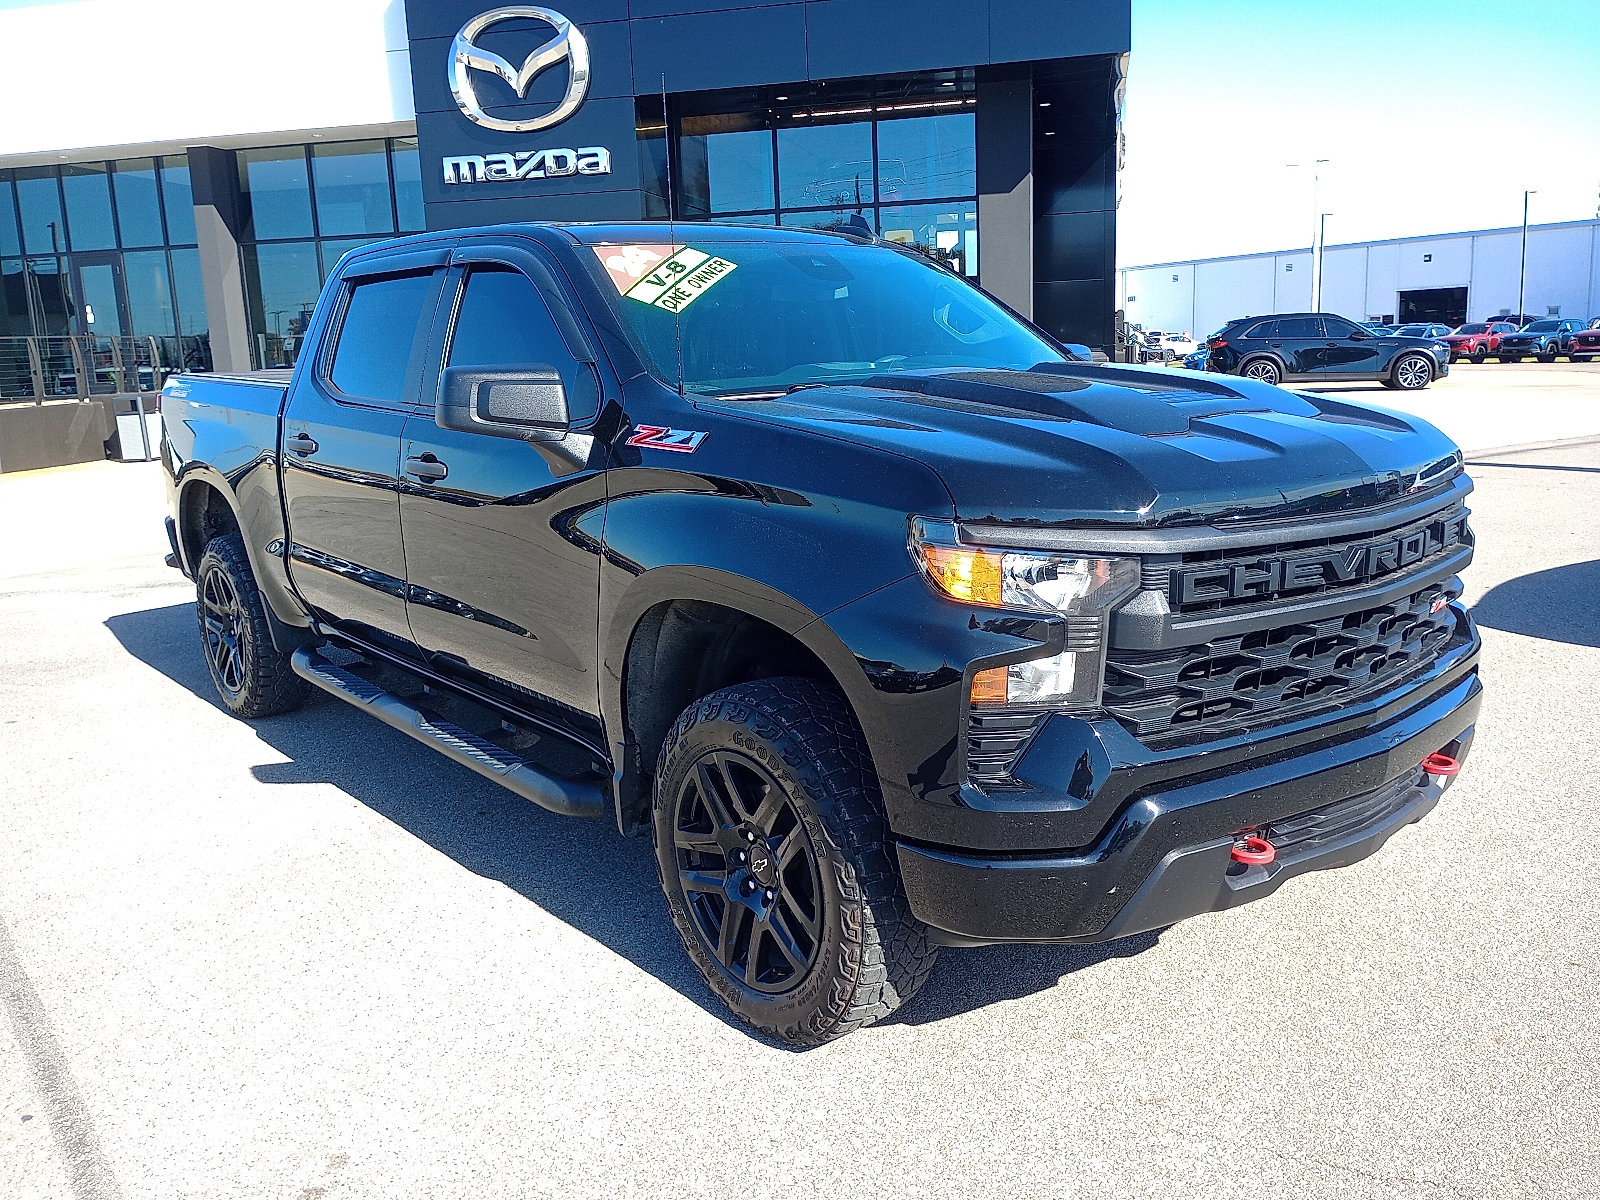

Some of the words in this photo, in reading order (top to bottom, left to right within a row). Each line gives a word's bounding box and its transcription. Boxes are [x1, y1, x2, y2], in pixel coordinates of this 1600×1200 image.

[442, 146, 612, 184] mazda
[645, 261, 687, 287] V-8
[661, 286, 693, 310] ONE
[688, 259, 731, 289] OWNER
[625, 423, 710, 454] Z71
[1170, 506, 1471, 604] CHEVROLET
[732, 730, 828, 859] GOODYEAR
